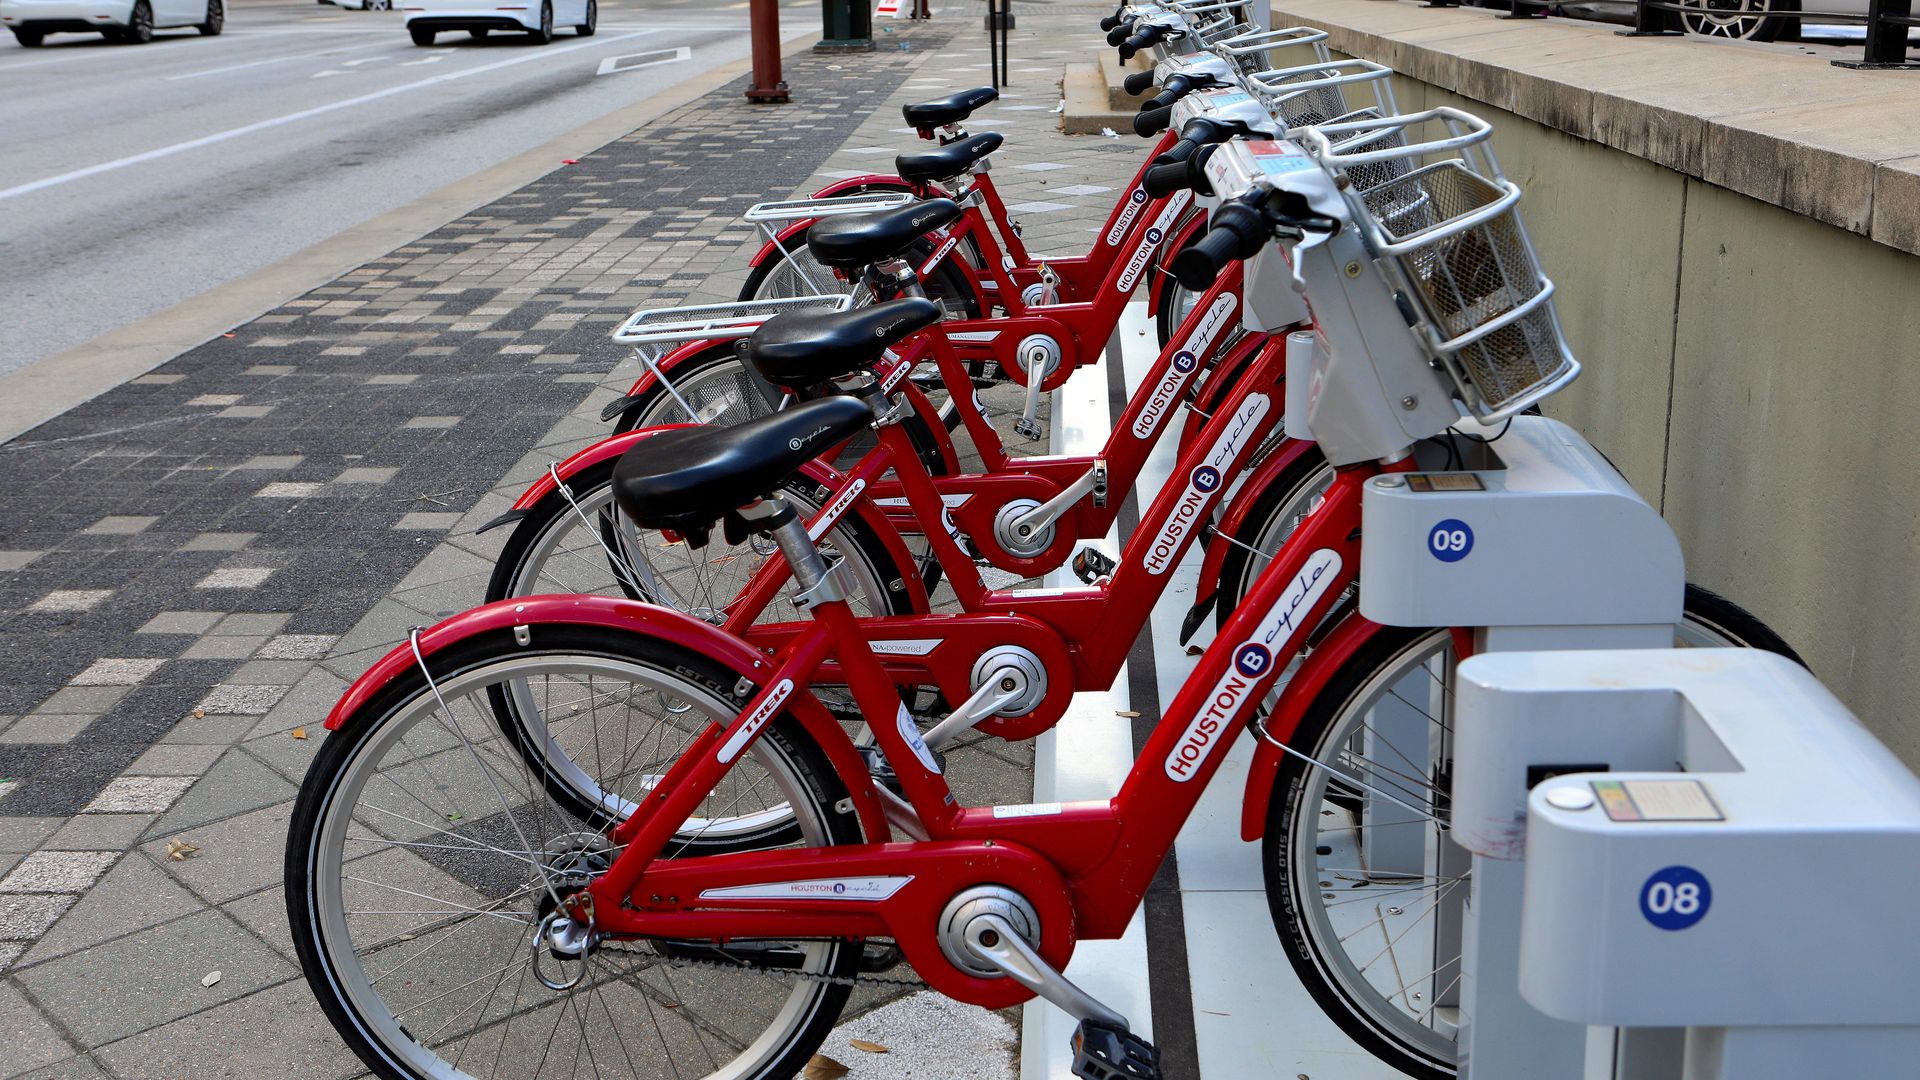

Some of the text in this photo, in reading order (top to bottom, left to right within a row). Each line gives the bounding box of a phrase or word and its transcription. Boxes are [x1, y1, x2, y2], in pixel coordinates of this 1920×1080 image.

[1109, 203, 1138, 243] HOUSTON
[935, 240, 954, 261] TREK
[1120, 243, 1152, 289] HOUSTON
[1136, 372, 1182, 435] HOUSTON
[826, 483, 861, 519] TREK
[1147, 492, 1203, 570] HOUSTON
[1433, 529, 1467, 551] 09
[1170, 676, 1248, 776] HOUSTON
[1265, 559, 1332, 644] cycle
[675, 665, 704, 680] CST
[767, 726, 794, 753] OTIS
[742, 686, 788, 734] TREK
[791, 884, 832, 892] HOUSTON
[1278, 834, 1311, 961] CST CLASSIC OTIS
[1647, 881, 1700, 915] 08
